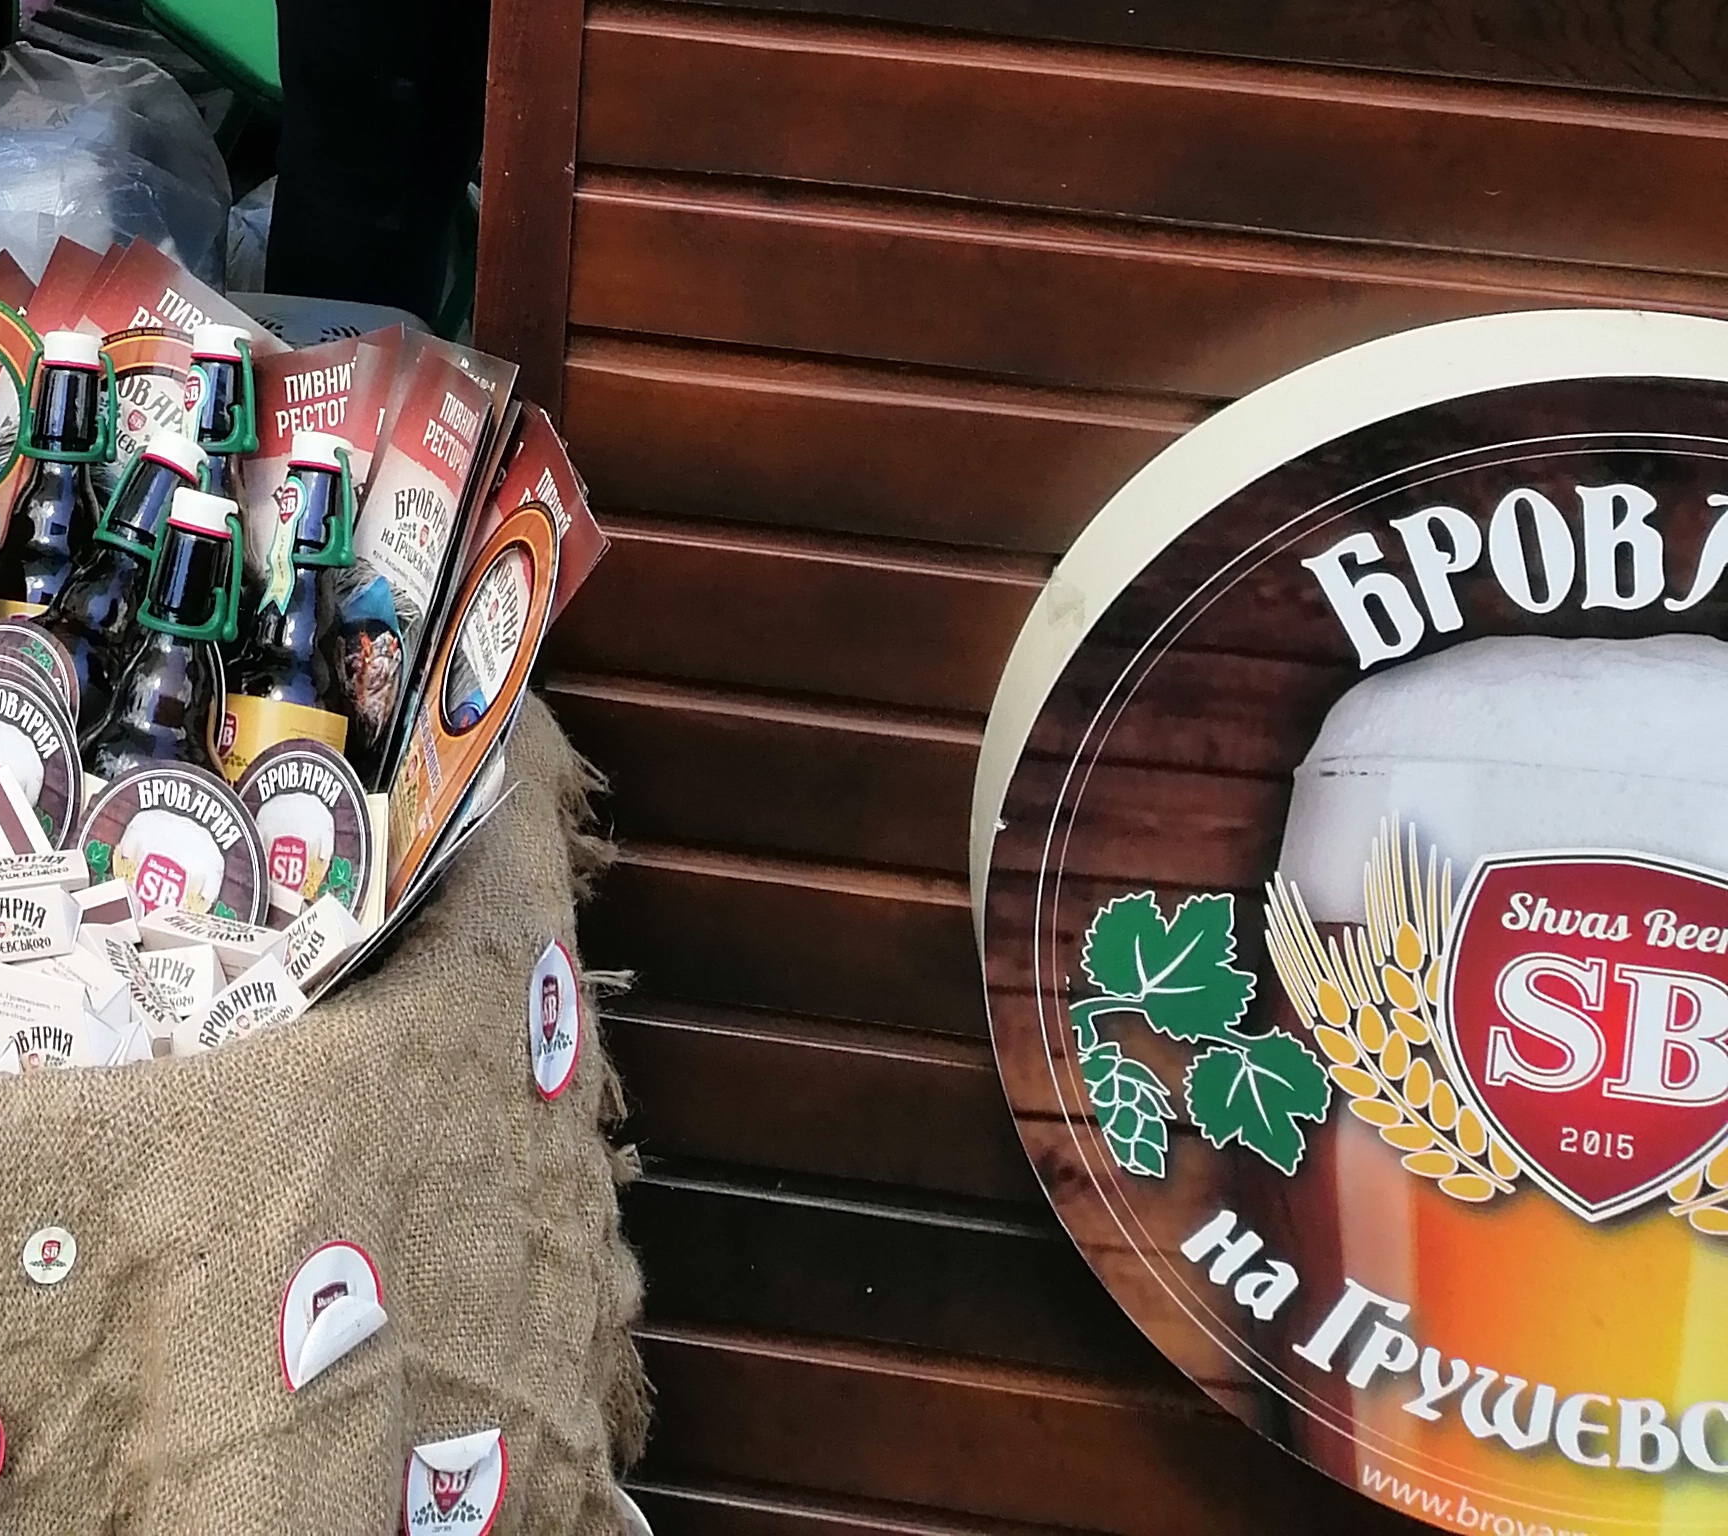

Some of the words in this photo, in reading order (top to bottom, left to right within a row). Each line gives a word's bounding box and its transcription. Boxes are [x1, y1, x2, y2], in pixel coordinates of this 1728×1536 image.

[280, 496, 298, 515] SB
[256, 761, 344, 808] БРОВАРНЯ
[137, 778, 242, 851] БРОВАРНЯ
[138, 870, 180, 907] SB
[272, 855, 303, 885] SB
[1500, 891, 1633, 942] Shvas
[198, 981, 279, 1049] БРОВАРНЯ
[1485, 950, 1728, 1108] SB
[1559, 1126, 1635, 1160] 2015
[1180, 1209, 1300, 1321] на
